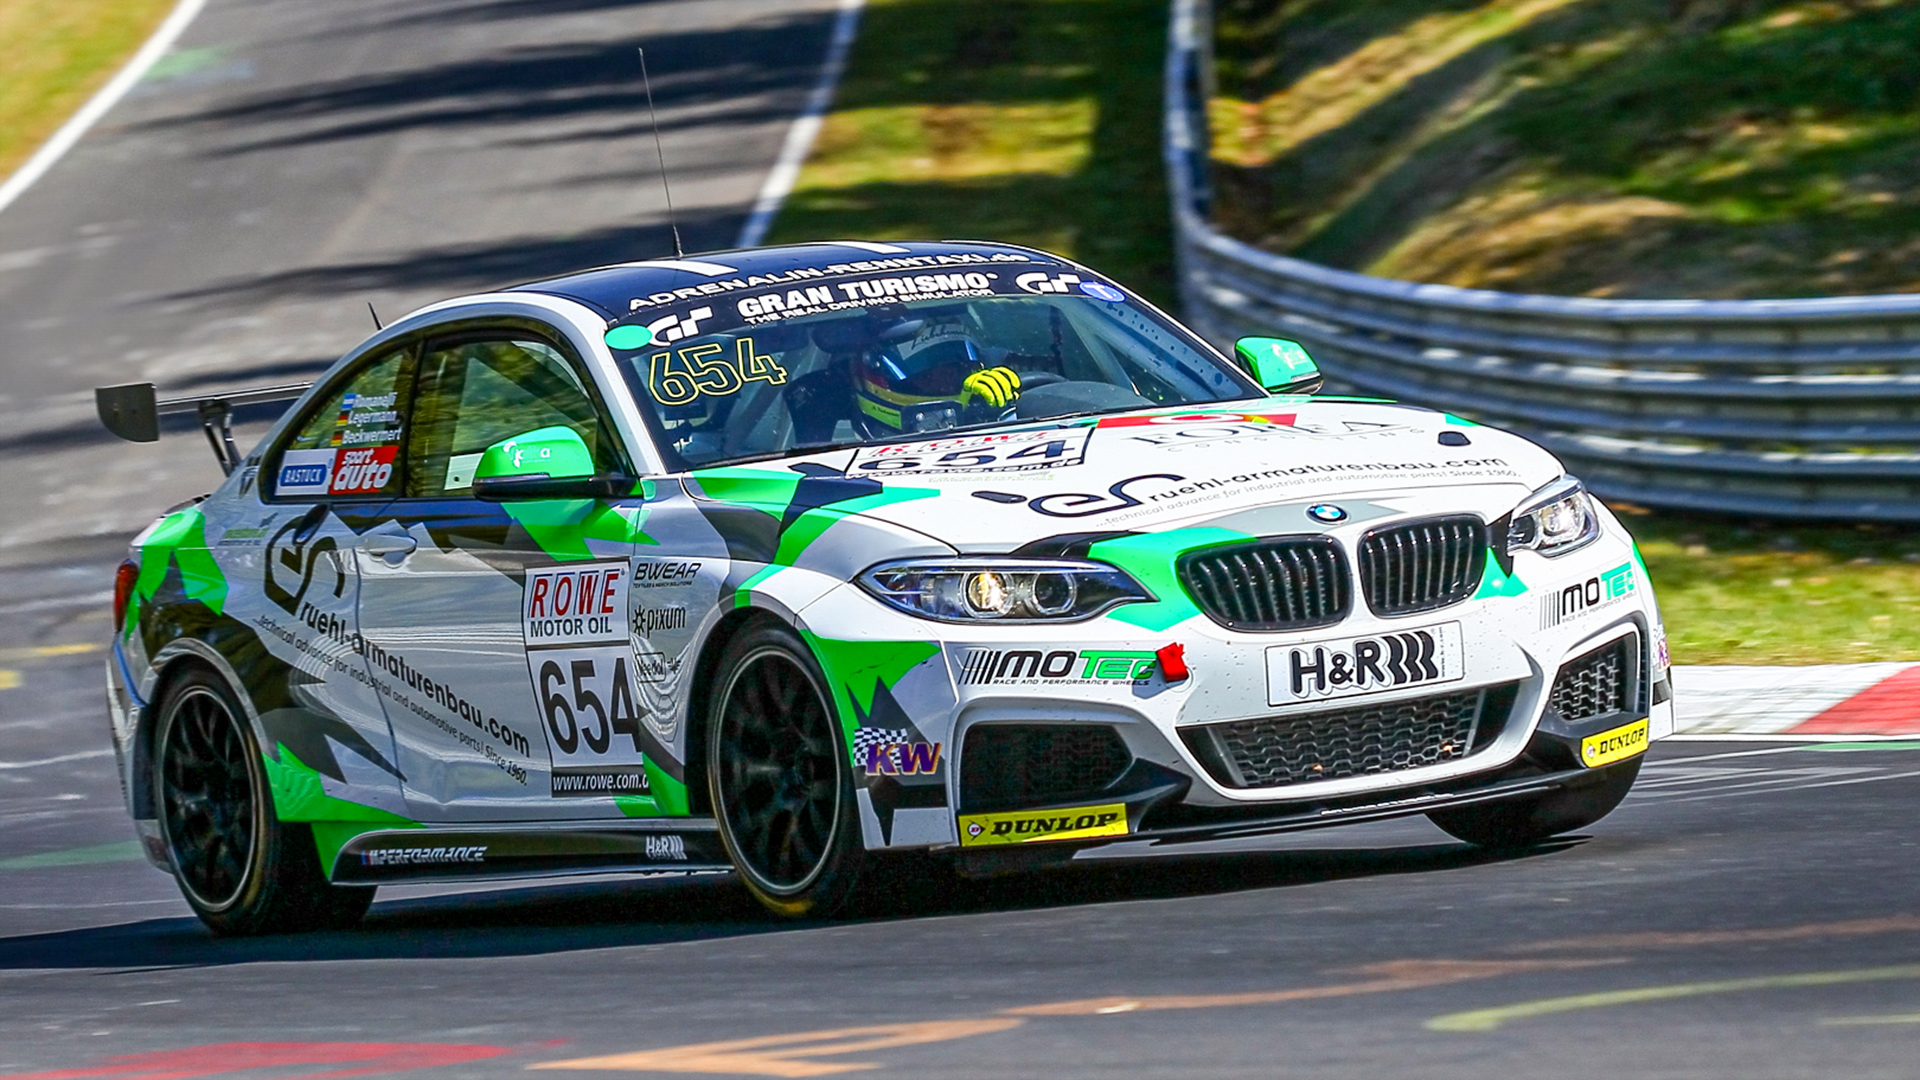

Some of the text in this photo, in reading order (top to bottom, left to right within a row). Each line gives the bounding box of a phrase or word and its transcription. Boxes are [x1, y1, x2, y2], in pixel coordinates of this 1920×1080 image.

[628, 252, 1030, 311] ADRENALIN-RENNTAXI.de
[737, 284, 834, 319] GRAN
[744, 288, 995, 326] THE REAL DRIVING SIMULATOR
[649, 337, 788, 407] 654
[341, 449, 375, 466] sport
[858, 440, 1075, 470] 654
[333, 460, 393, 491] auto
[1148, 457, 1509, 502] ruehl-armaturenbau.com
[1166, 493, 1222, 511] advance
[1222, 487, 1242, 500] for
[1308, 475, 1333, 484] and
[634, 562, 702, 581] BWEAR
[527, 568, 621, 619] ROWE
[530, 616, 613, 638] MOTOR OIL
[646, 606, 687, 639] pixum
[295, 638, 334, 668] advance
[333, 656, 350, 674] for
[350, 664, 392, 698] industrial
[393, 690, 409, 709] and
[410, 702, 458, 738] automotive
[299, 602, 531, 759] ruehl-armaturenbau.com
[992, 678, 1017, 686] RACE
[1042, 678, 1109, 686] PERFORMANCE
[1112, 679, 1150, 687] WHEELS
[540, 657, 643, 755] 654
[1598, 726, 1645, 756] DUNLOP
[864, 742, 941, 776] KW
[989, 811, 1119, 837] DUNLOP
